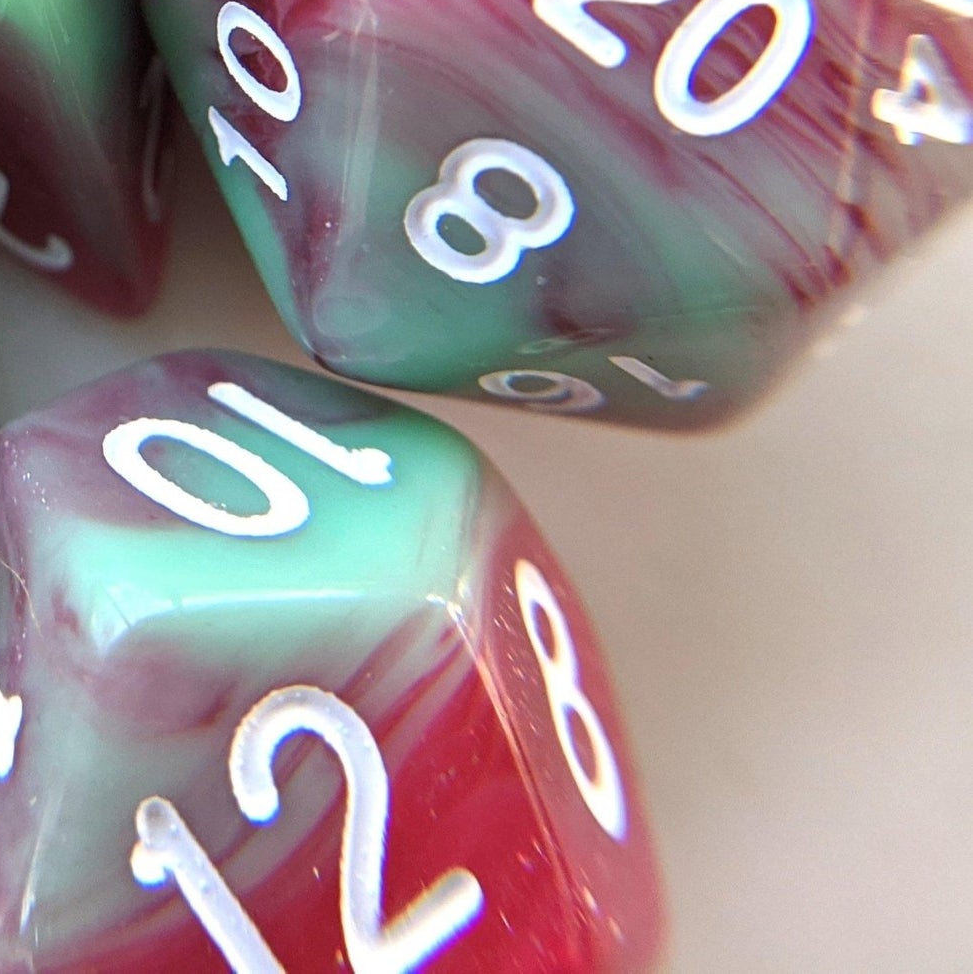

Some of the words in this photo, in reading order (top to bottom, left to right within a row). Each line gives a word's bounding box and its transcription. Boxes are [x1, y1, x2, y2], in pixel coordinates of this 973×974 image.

[207, 0, 302, 202] 10
[404, 137, 576, 285] 8
[102, 381, 393, 538] 10
[514, 558, 627, 842] 8
[130, 683, 484, 974] 12
